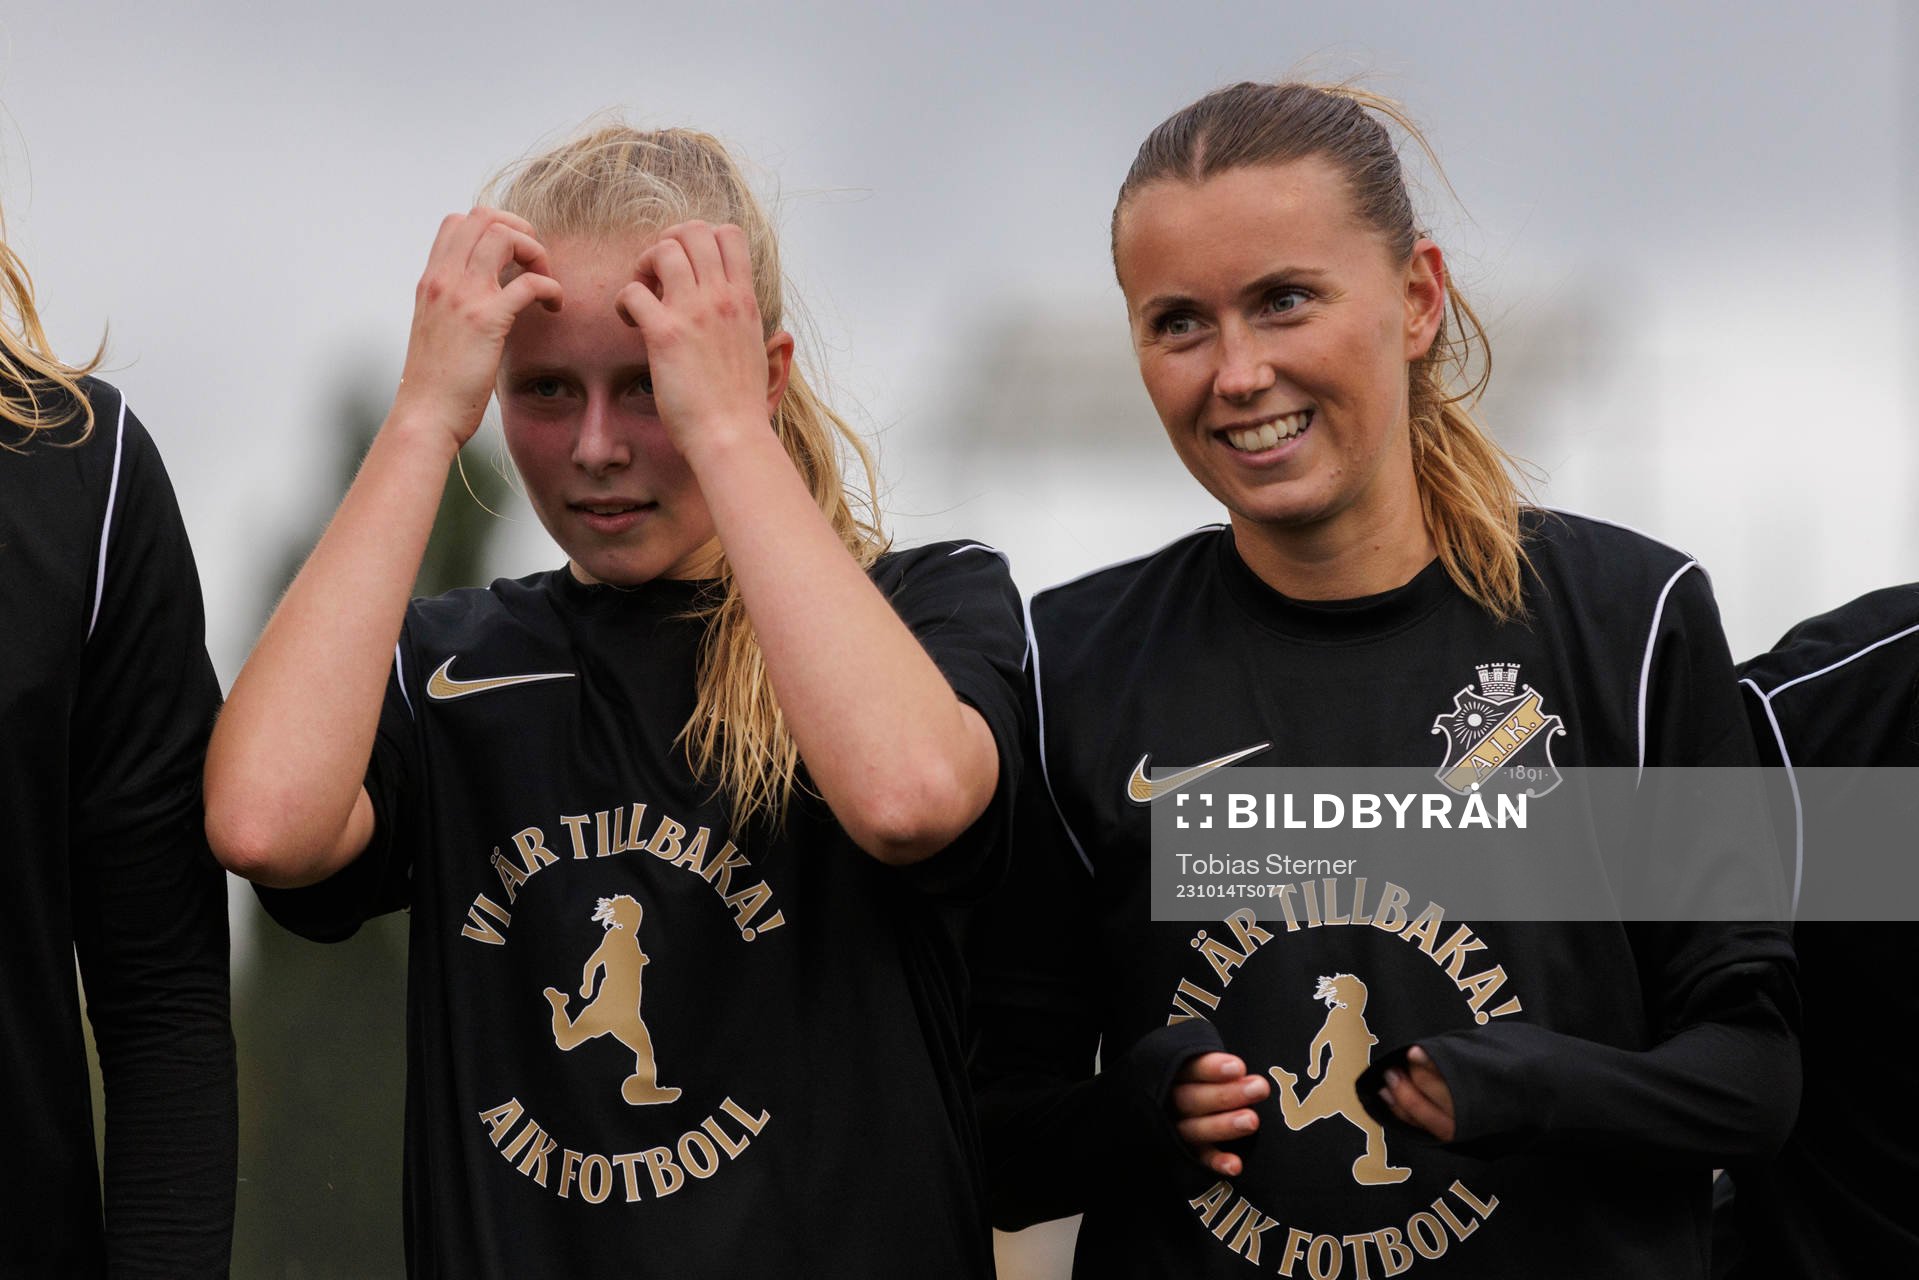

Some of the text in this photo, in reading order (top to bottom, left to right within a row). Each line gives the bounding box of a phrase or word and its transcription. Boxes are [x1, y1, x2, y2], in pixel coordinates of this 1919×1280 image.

[461, 803, 786, 946] VI ÄR TILLBAKA!
[1190, 907, 1275, 988] ÄR
[1276, 877, 1523, 1026] TILLBAKA!
[478, 1096, 771, 1204] AIK FOTBOLL
[1188, 1179, 1500, 1280] AIK FOTBOLL
